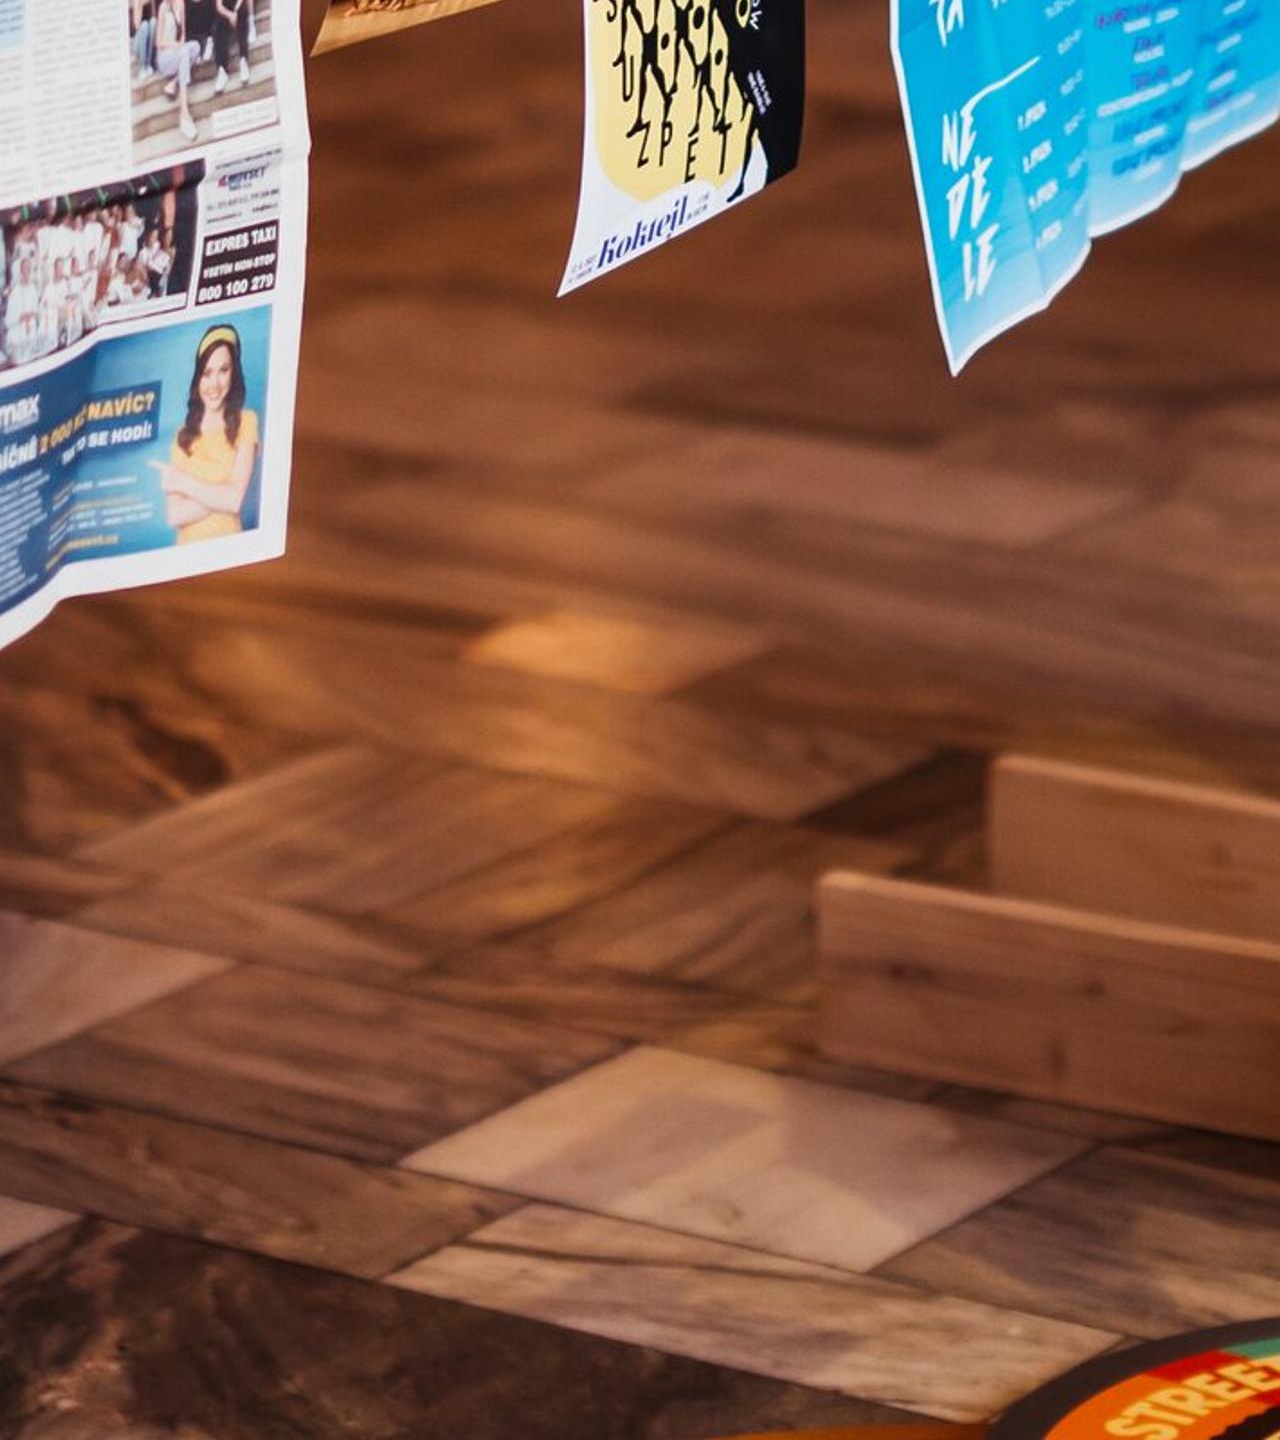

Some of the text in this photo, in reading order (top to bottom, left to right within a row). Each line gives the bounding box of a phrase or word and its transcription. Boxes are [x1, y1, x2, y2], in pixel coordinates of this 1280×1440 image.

[205, 224, 277, 258] EXPRES TAXI
[87, 390, 155, 422] NAVÍC?
